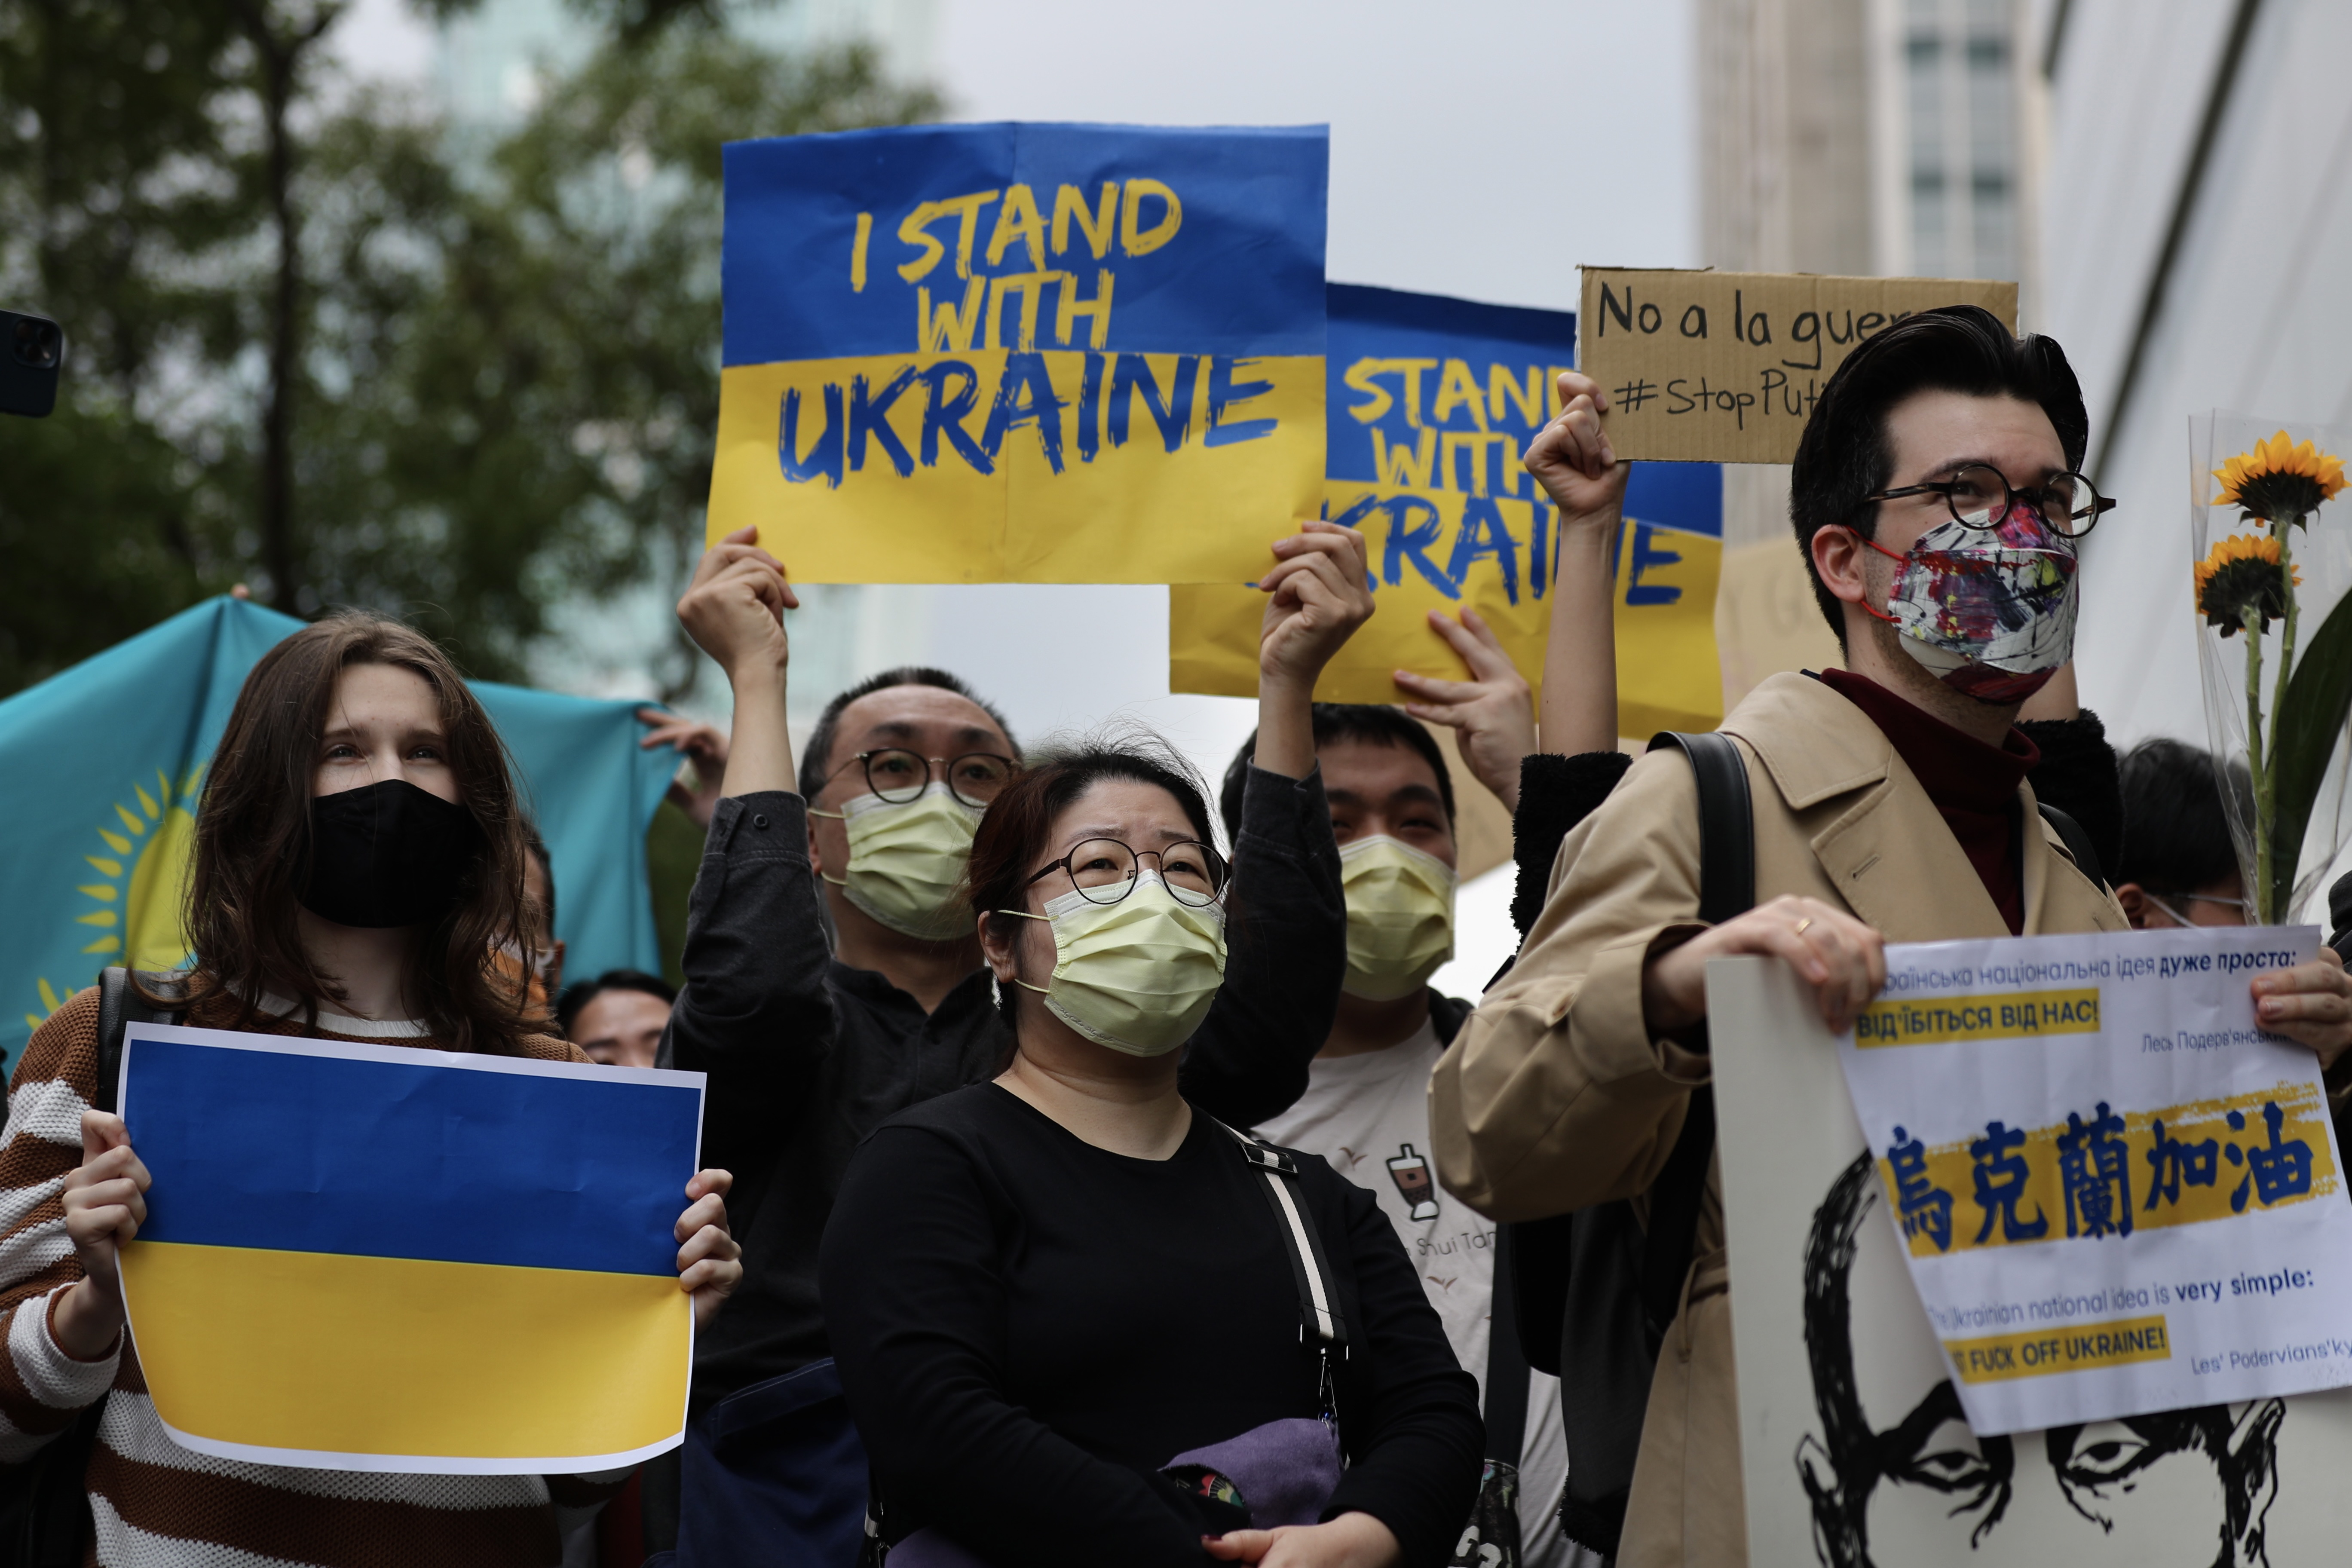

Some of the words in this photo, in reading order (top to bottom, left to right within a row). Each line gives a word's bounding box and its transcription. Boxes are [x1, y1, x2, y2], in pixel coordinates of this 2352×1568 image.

[851, 211, 873, 293] I
[897, 178, 1183, 285] STAND
[917, 268, 1115, 354] WITH
[1599, 282, 1663, 338] No
[1680, 304, 1707, 339] a
[1735, 289, 1772, 346] la
[1782, 309, 1912, 370] guer
[778, 350, 1279, 490] UKRAINE
[1614, 368, 1825, 430] #StopPut
[1880, 965, 1974, 998] раїнська
[1981, 958, 2110, 987] національна
[2116, 954, 2155, 982] ідея
[2160, 952, 2211, 979] дуже
[2218, 950, 2297, 974] проста:
[2001, 1003, 2038, 1032] ВІД
[2043, 999, 2098, 1025] НАС!
[2142, 1034, 2174, 1053] Лесь
[1888, 1101, 2315, 1252] 烏克蘭加油
[2028, 1289, 2108, 1321] national
[2110, 1286, 2148, 1311] idea
[2153, 1282, 2170, 1305] is
[2174, 1280, 2221, 1303] very
[2231, 1266, 2314, 1296] simple:
[1969, 1344, 2017, 1374] FUCK
[2021, 1339, 2061, 1367] OFF
[2065, 1326, 2166, 1362] UKRAINE!
[2192, 1353, 2223, 1375] Les'
